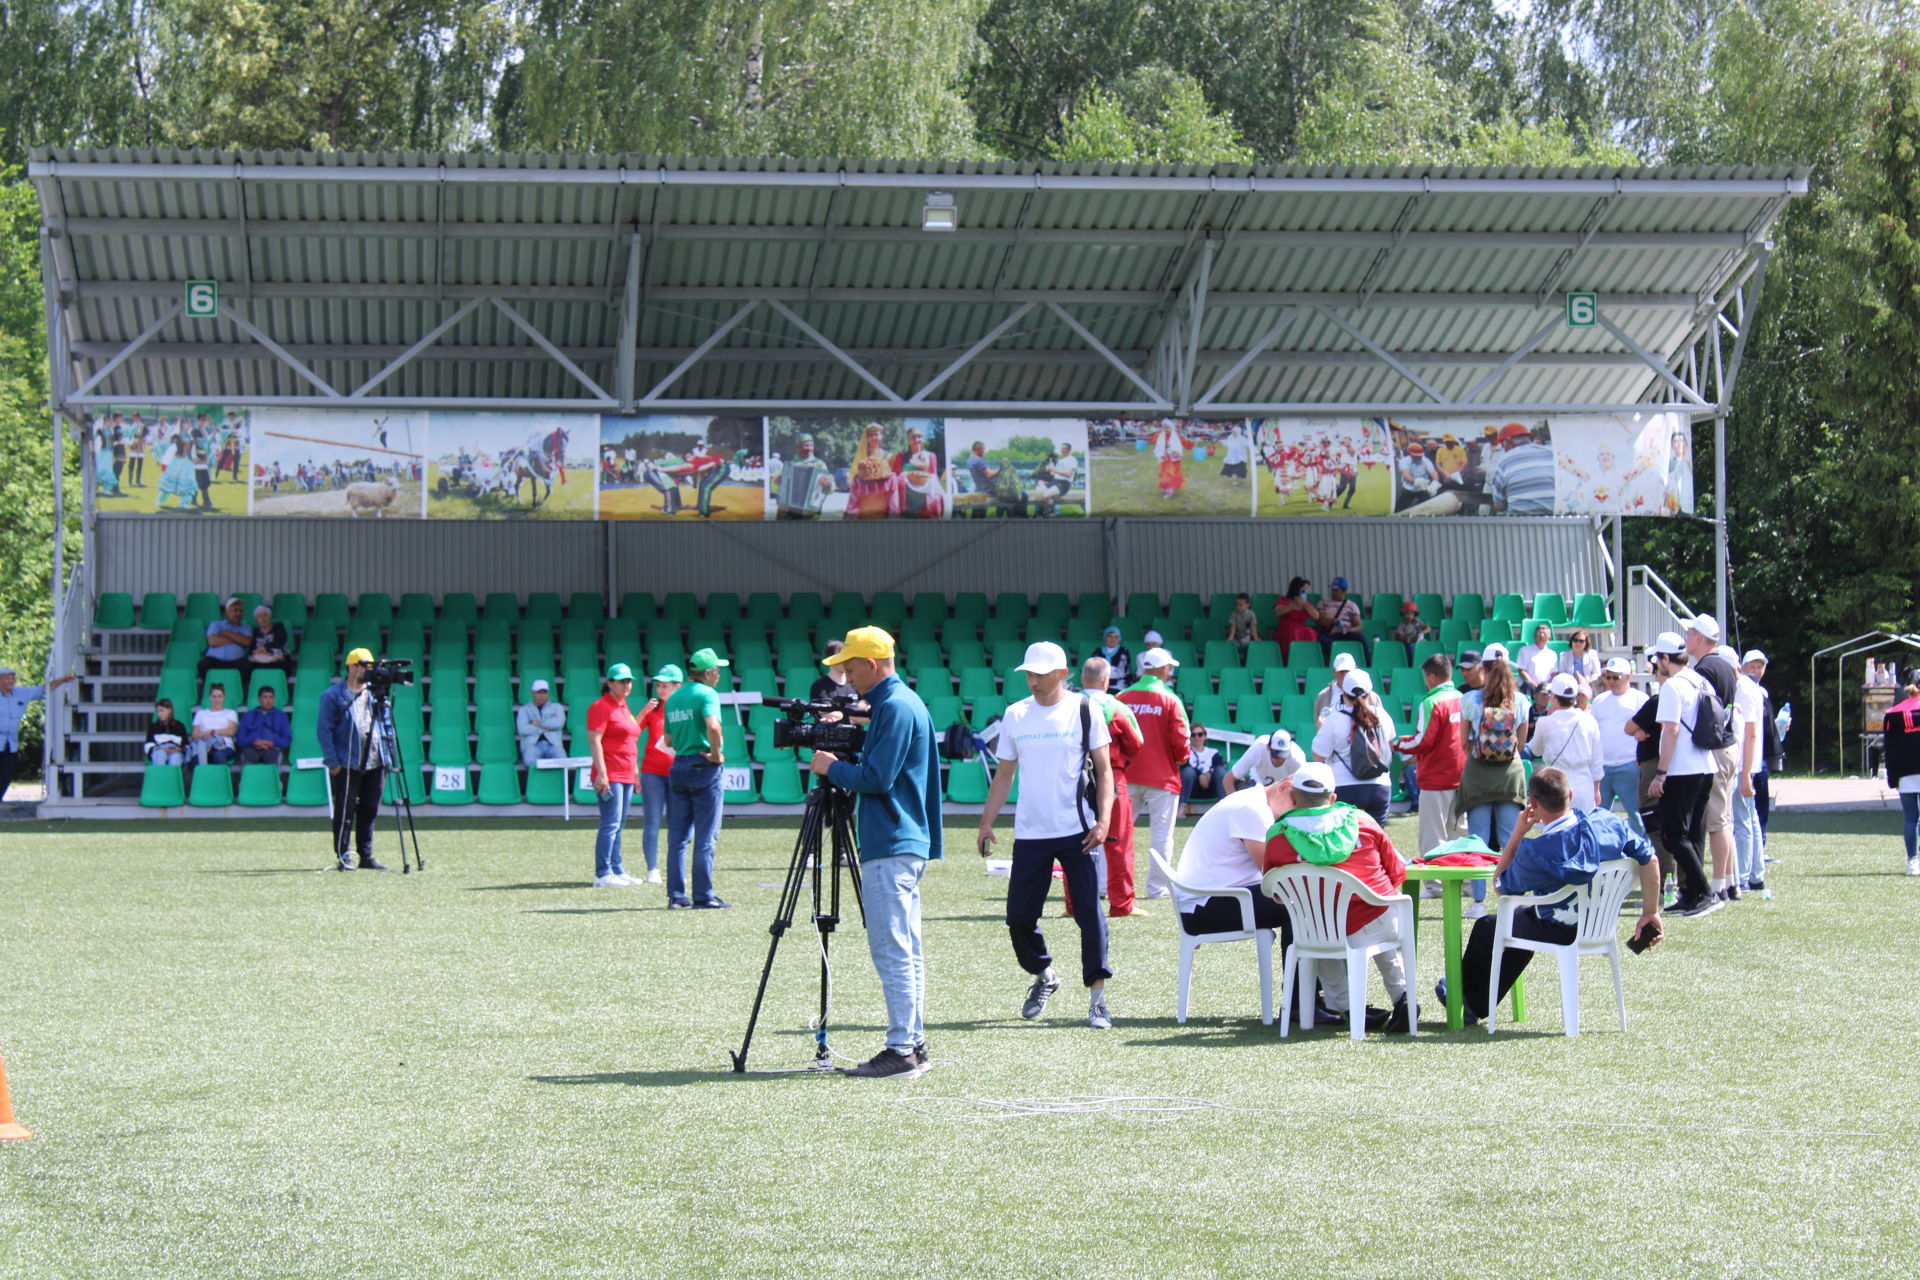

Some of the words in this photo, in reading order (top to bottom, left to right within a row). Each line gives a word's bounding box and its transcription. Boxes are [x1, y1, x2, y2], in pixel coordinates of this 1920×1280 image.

[191, 285, 213, 312] 6
[1572, 296, 1594, 323] 6
[441, 773, 460, 789] 28
[725, 774, 745, 789] 30
